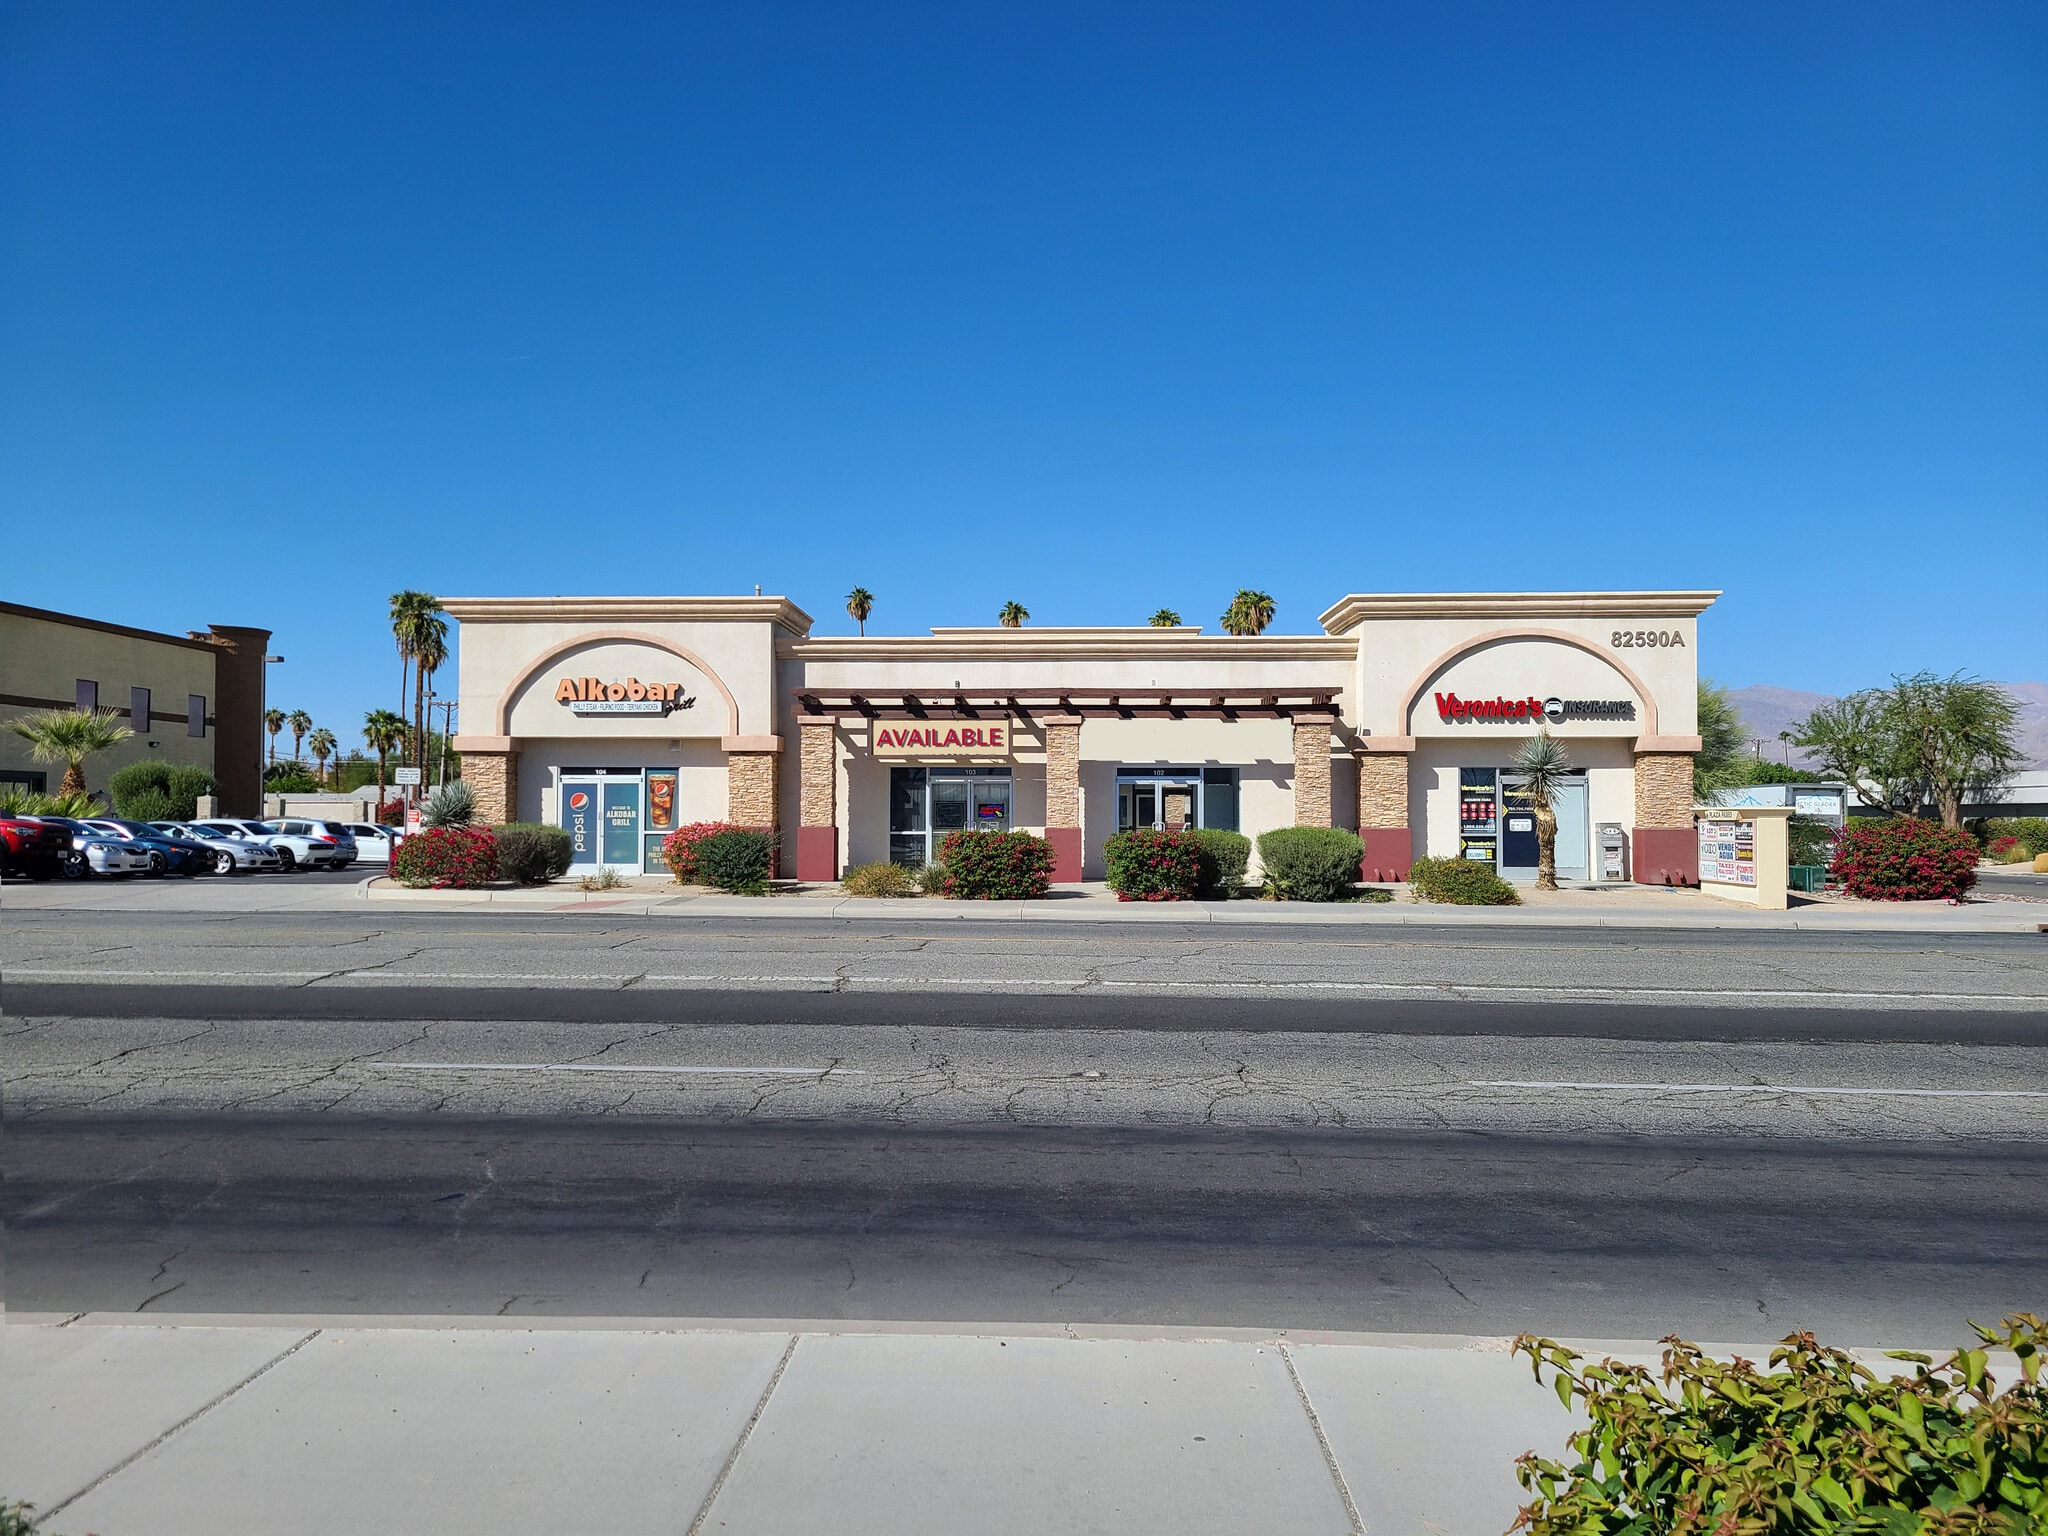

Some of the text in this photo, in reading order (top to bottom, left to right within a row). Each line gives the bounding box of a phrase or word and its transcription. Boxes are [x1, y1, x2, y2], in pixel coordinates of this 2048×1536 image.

[1610, 630, 1686, 648] 82590A
[554, 676, 681, 702] Alkobar
[586, 703, 597, 711] STEAK
[615, 703, 625, 711] FOOD
[1434, 692, 1634, 718] Veronica's INSURANCE
[876, 727, 1005, 748] AVAILABLE
[606, 810, 637, 818] ALKOBAR
[612, 818, 631, 826] GRILL
[572, 814, 587, 852] pepsi
[1717, 843, 1734, 852] VENDE
[1718, 851, 1734, 861] AGUA
[1718, 862, 1734, 870] TAXES
